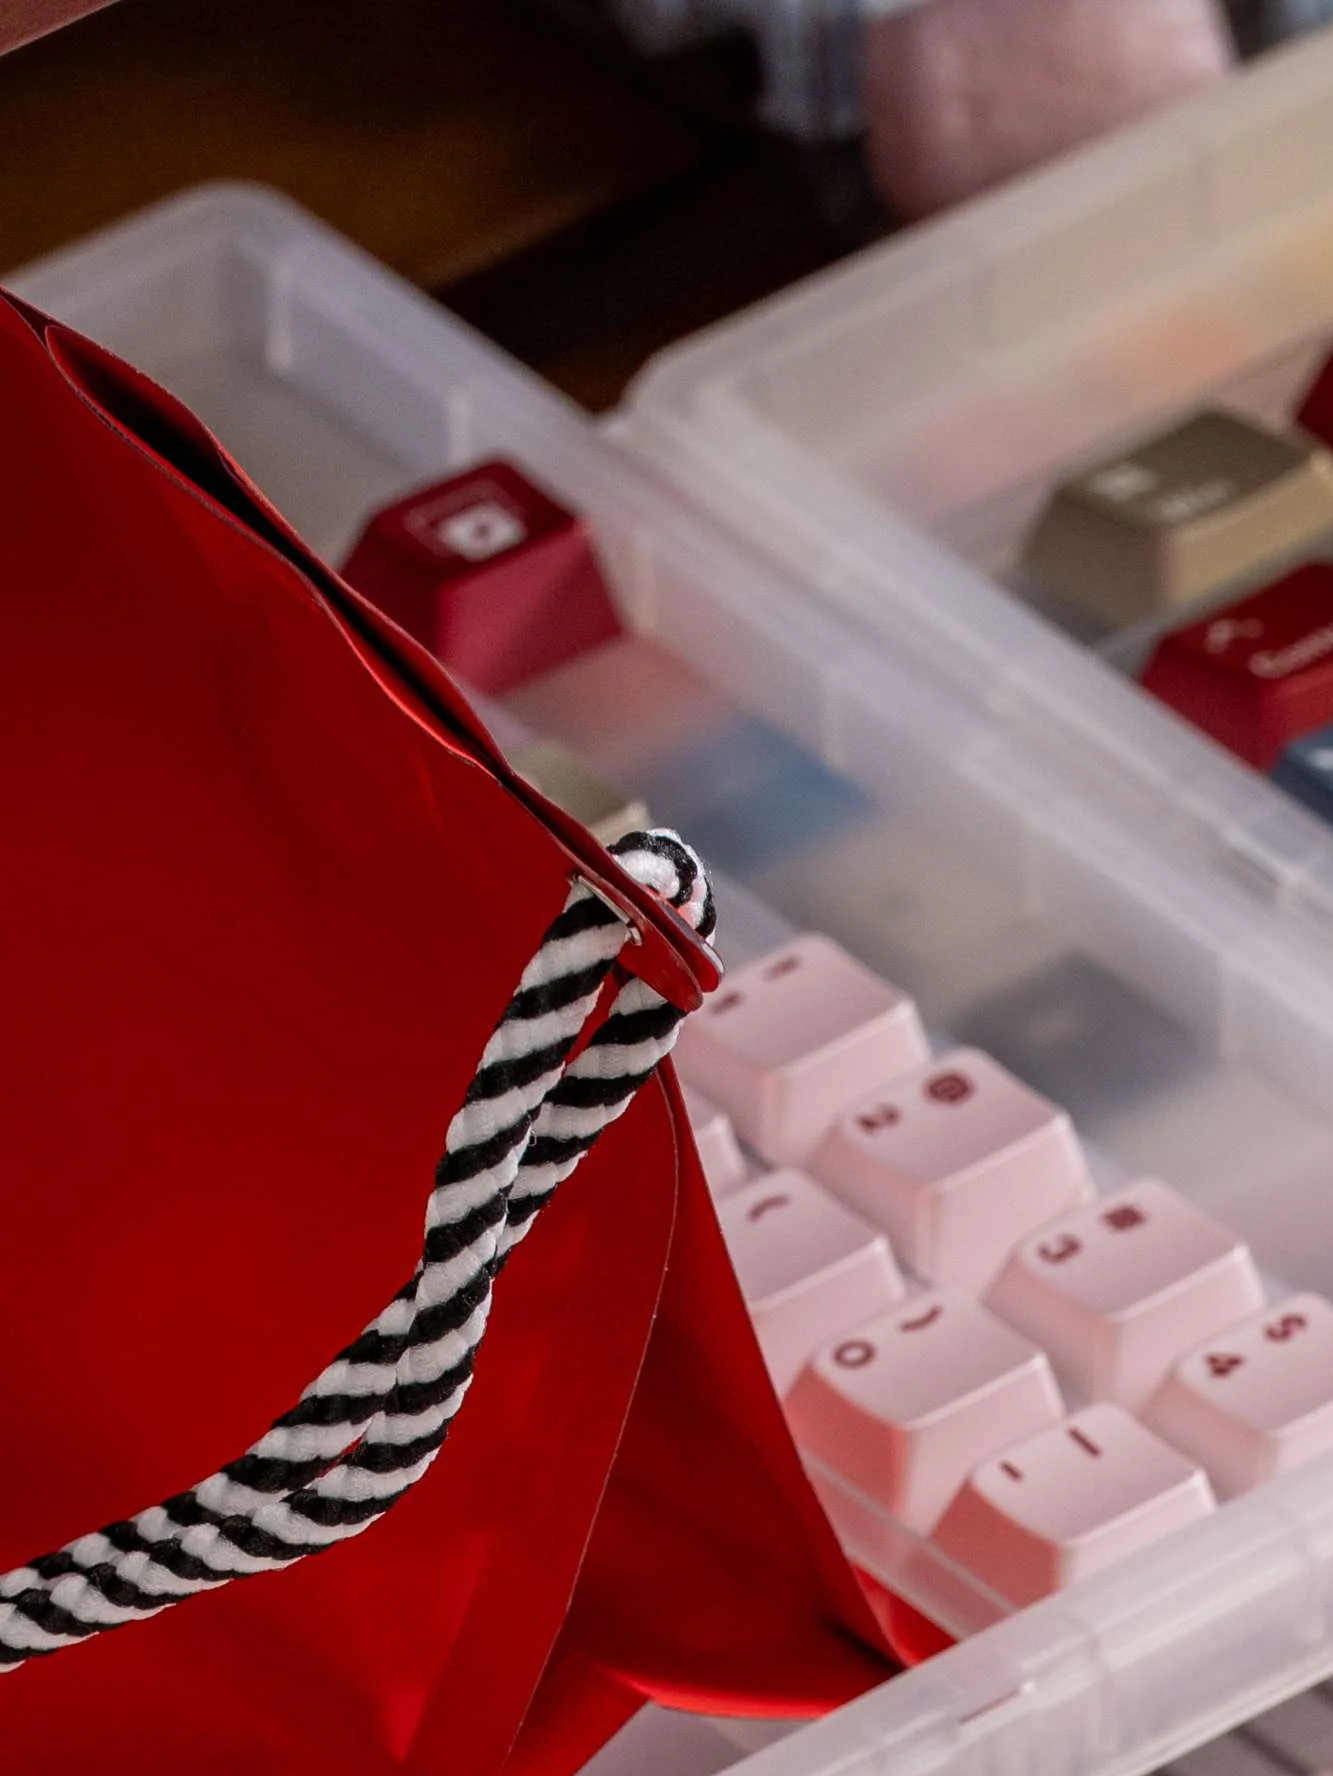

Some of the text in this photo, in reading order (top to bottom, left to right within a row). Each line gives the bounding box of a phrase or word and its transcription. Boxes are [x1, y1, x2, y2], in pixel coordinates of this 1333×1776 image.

[857, 1104, 900, 1135] 2
[1040, 1235, 1081, 1265] 3
[1205, 1351, 1244, 1378] 4
